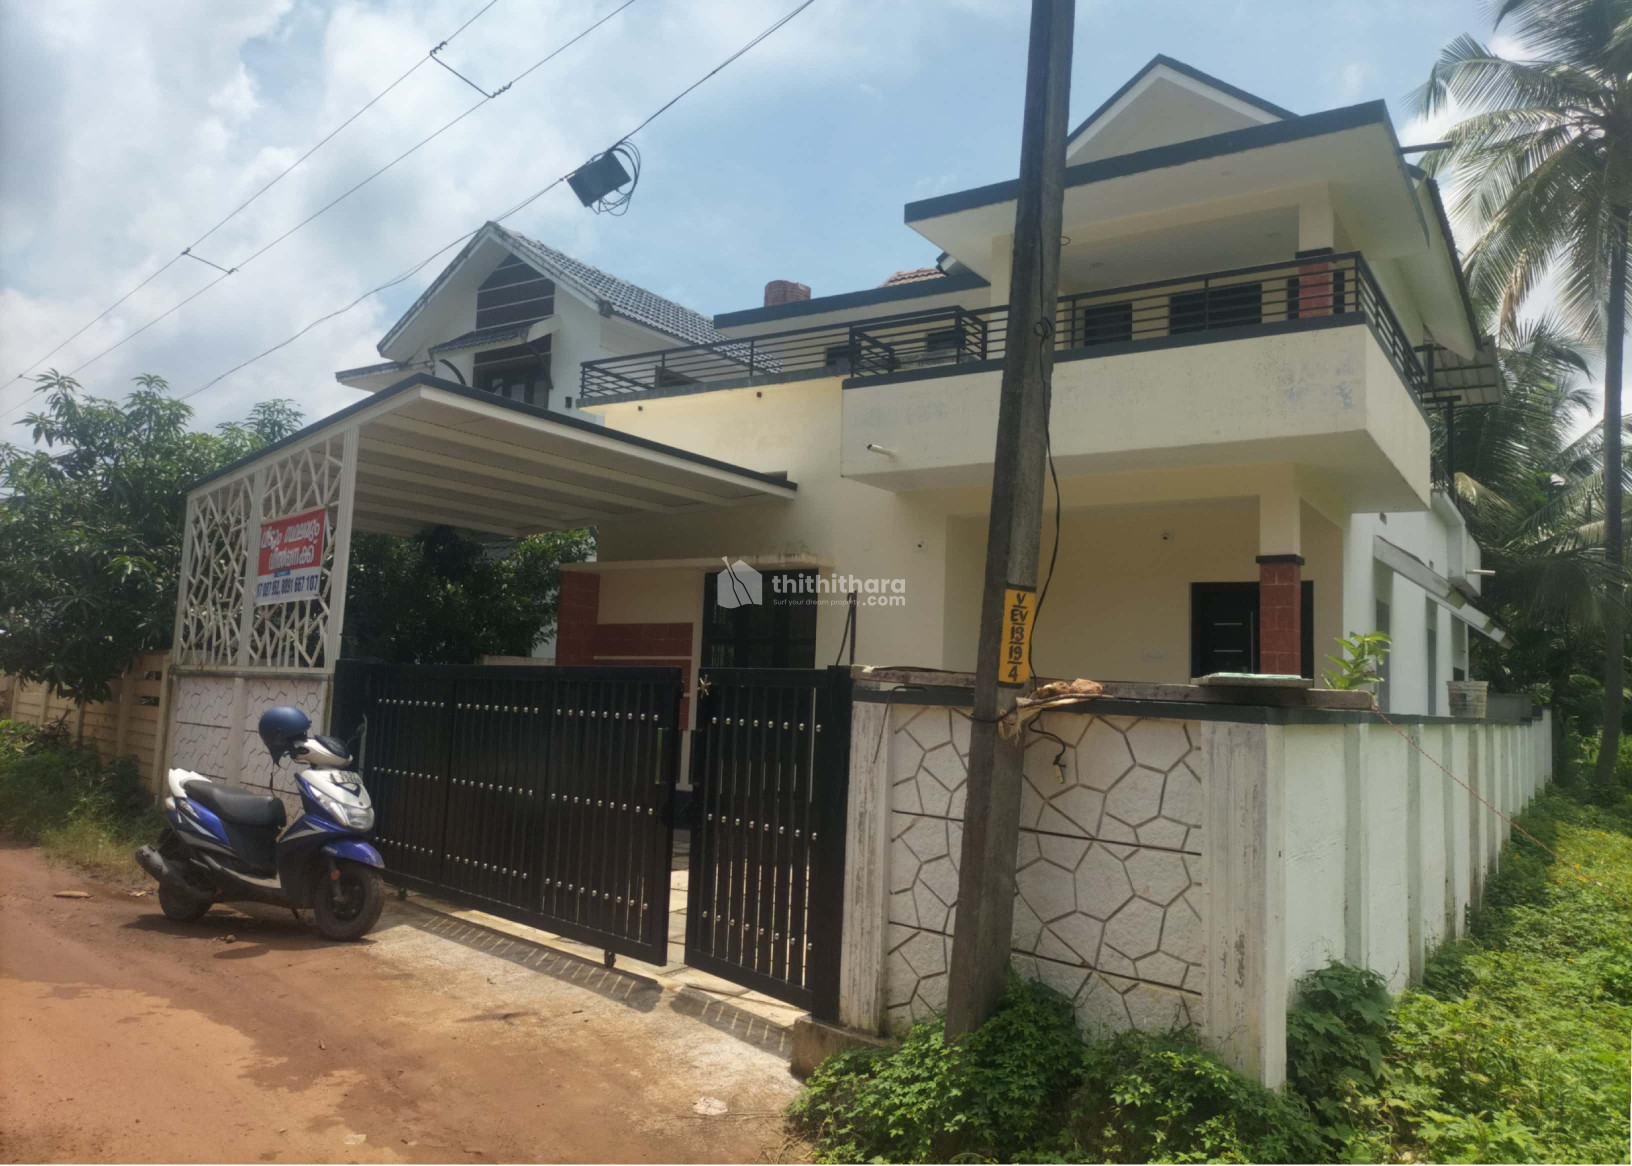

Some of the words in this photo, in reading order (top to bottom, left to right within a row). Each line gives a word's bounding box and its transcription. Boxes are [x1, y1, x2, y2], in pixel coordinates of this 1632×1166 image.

[306, 575, 319, 591] 107
[1010, 608, 1028, 623] EV
[1008, 645, 1023, 661] 19
[1008, 665, 1019, 682] 4
